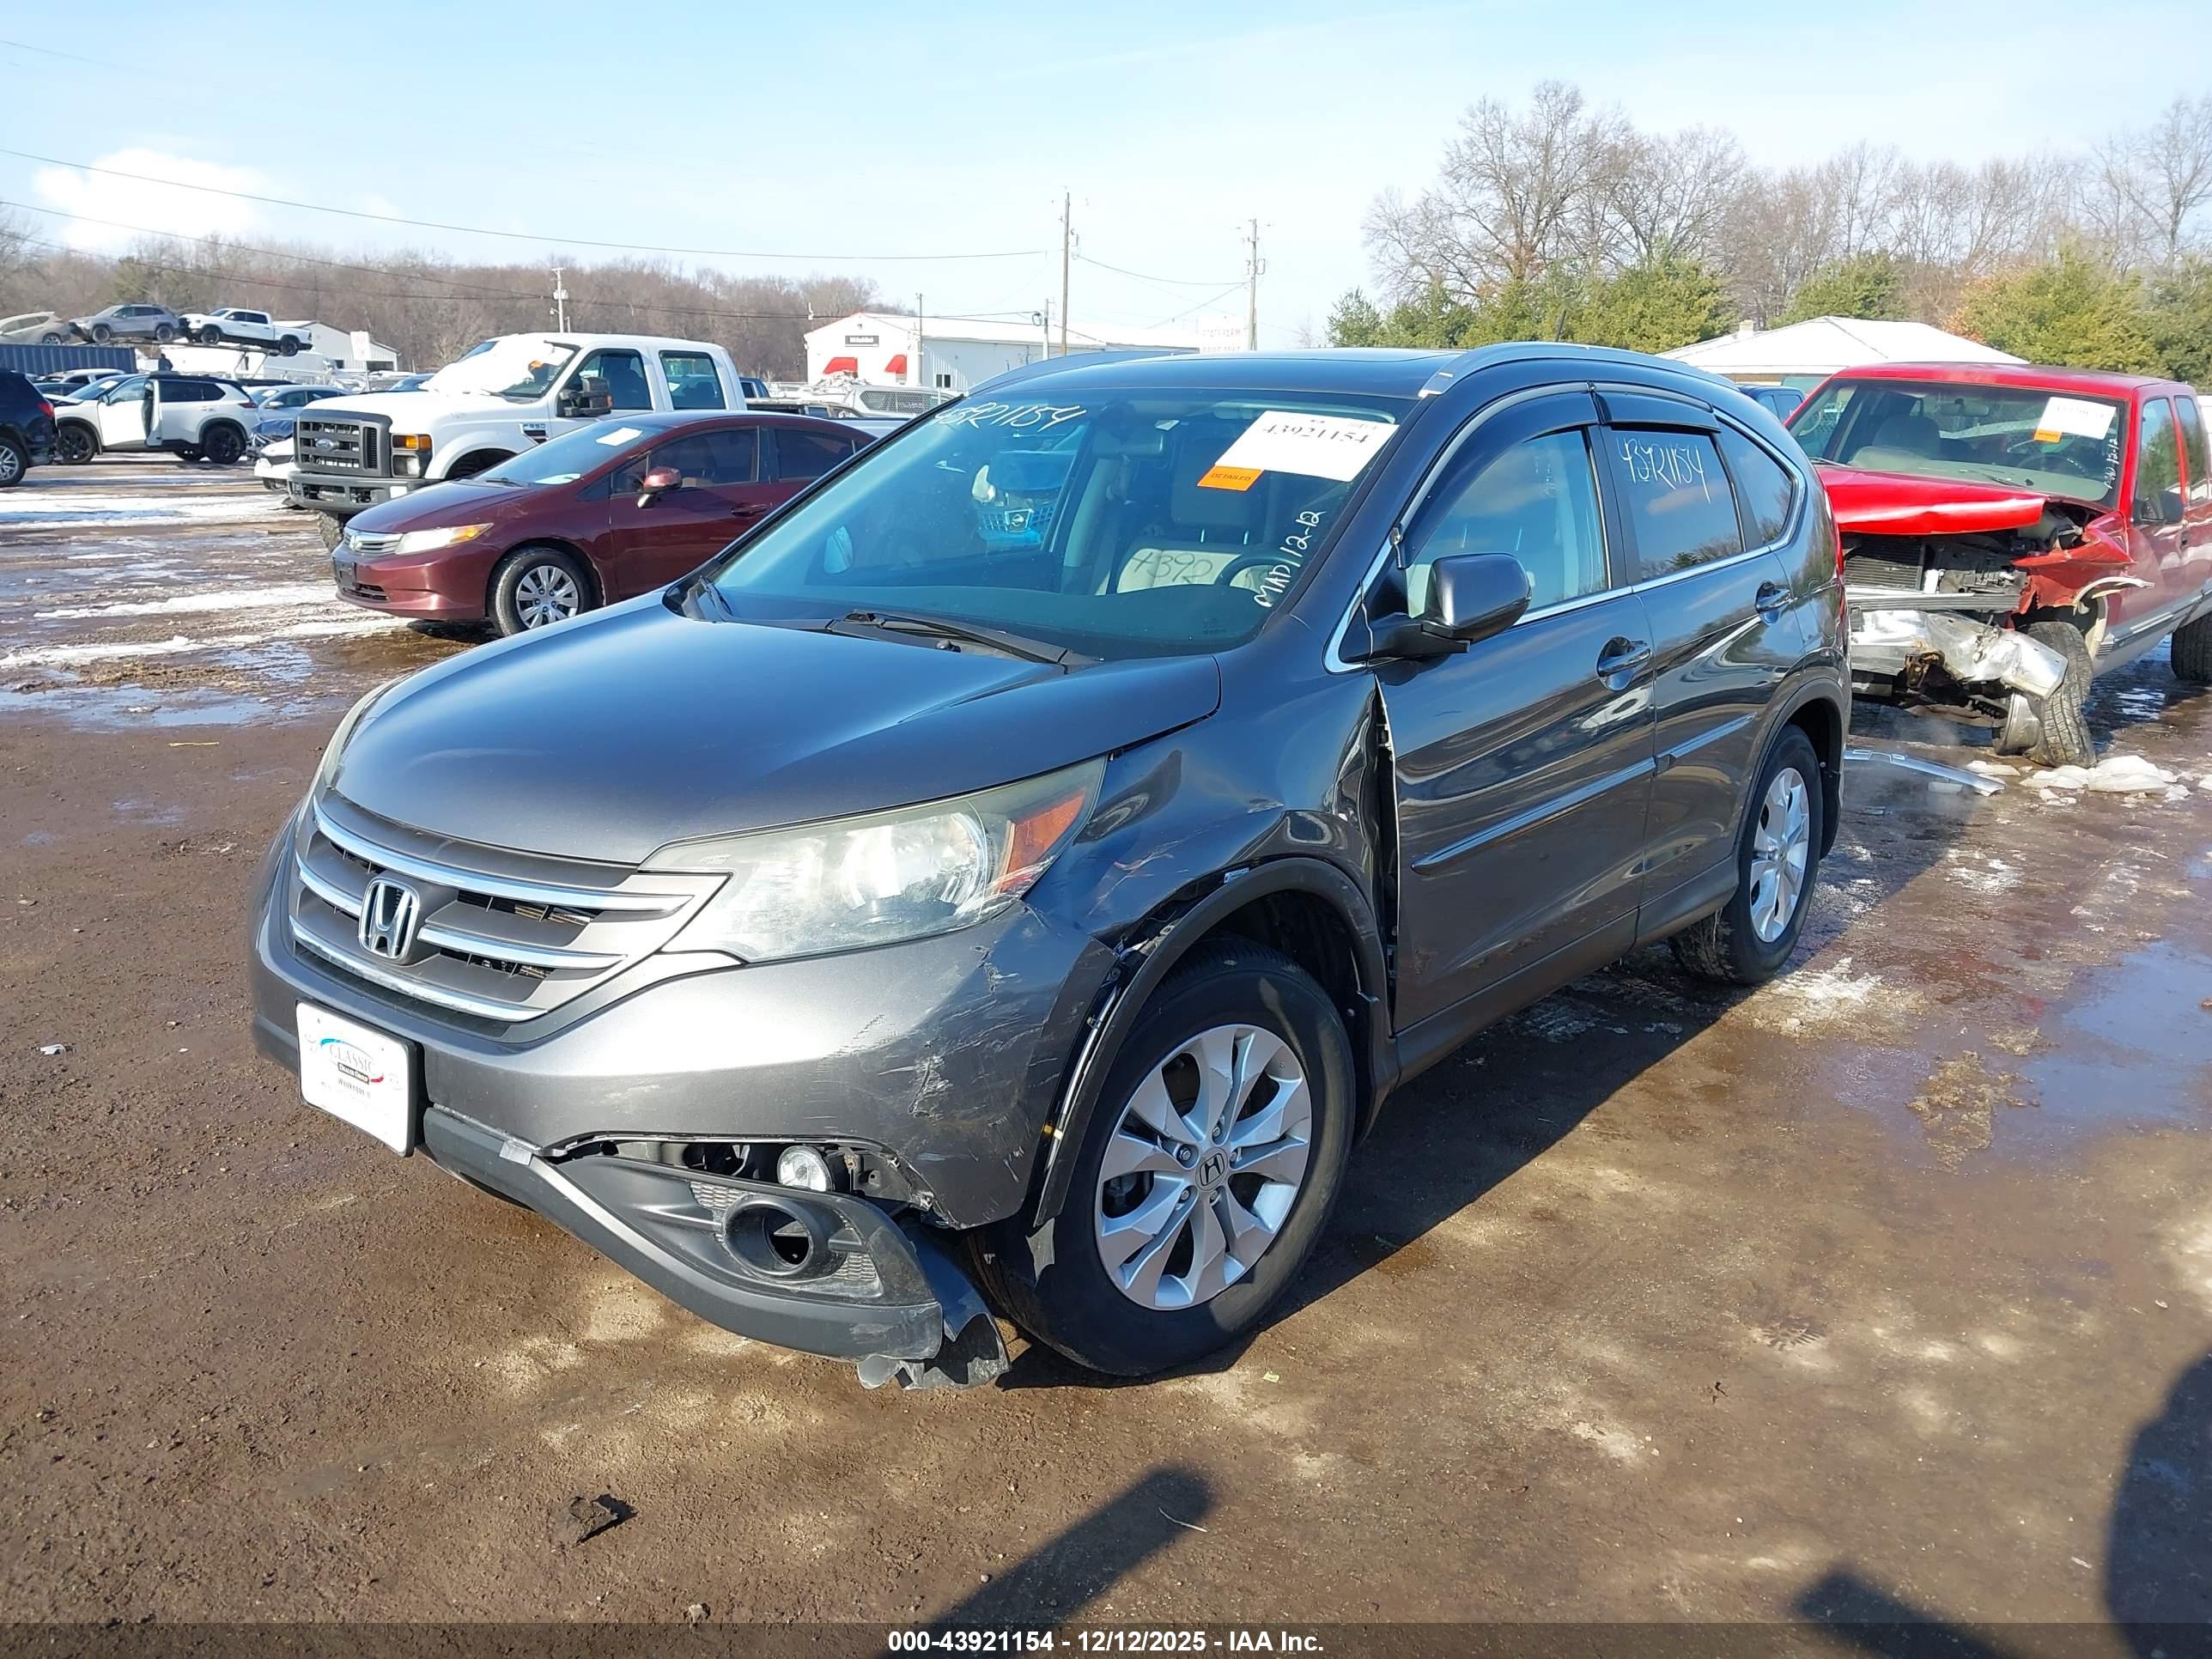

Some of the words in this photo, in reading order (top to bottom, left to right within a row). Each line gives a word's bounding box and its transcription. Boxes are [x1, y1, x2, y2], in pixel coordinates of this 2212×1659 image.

[1262, 423, 1370, 445] 43921154
[1210, 472, 1252, 482] DETAILED
[329, 1043, 372, 1073] CLASSIC
